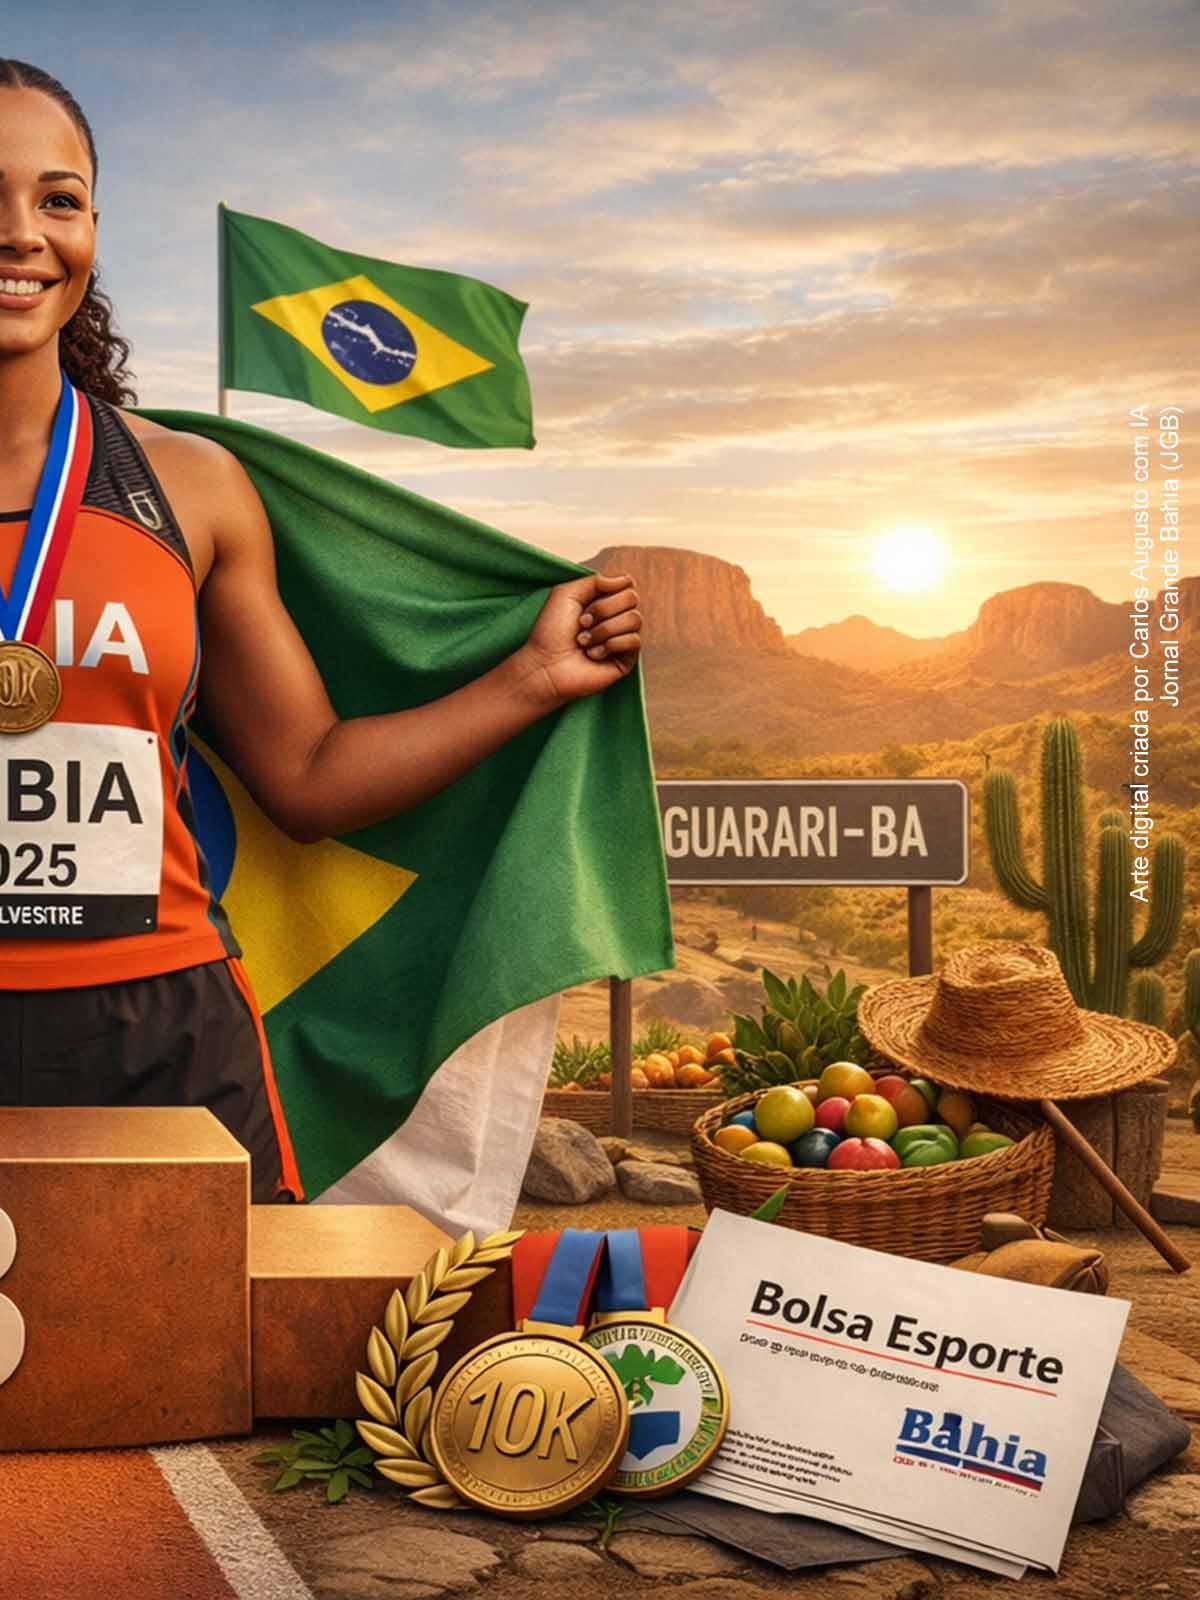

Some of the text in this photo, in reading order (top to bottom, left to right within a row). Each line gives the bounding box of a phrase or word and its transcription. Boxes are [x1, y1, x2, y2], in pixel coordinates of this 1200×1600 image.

[663, 805, 929, 858] GUARARI-BA
[750, 1280, 874, 1342] Bolsa
[886, 1314, 1064, 1385] Esporte
[465, 1380, 596, 1463] 10K
